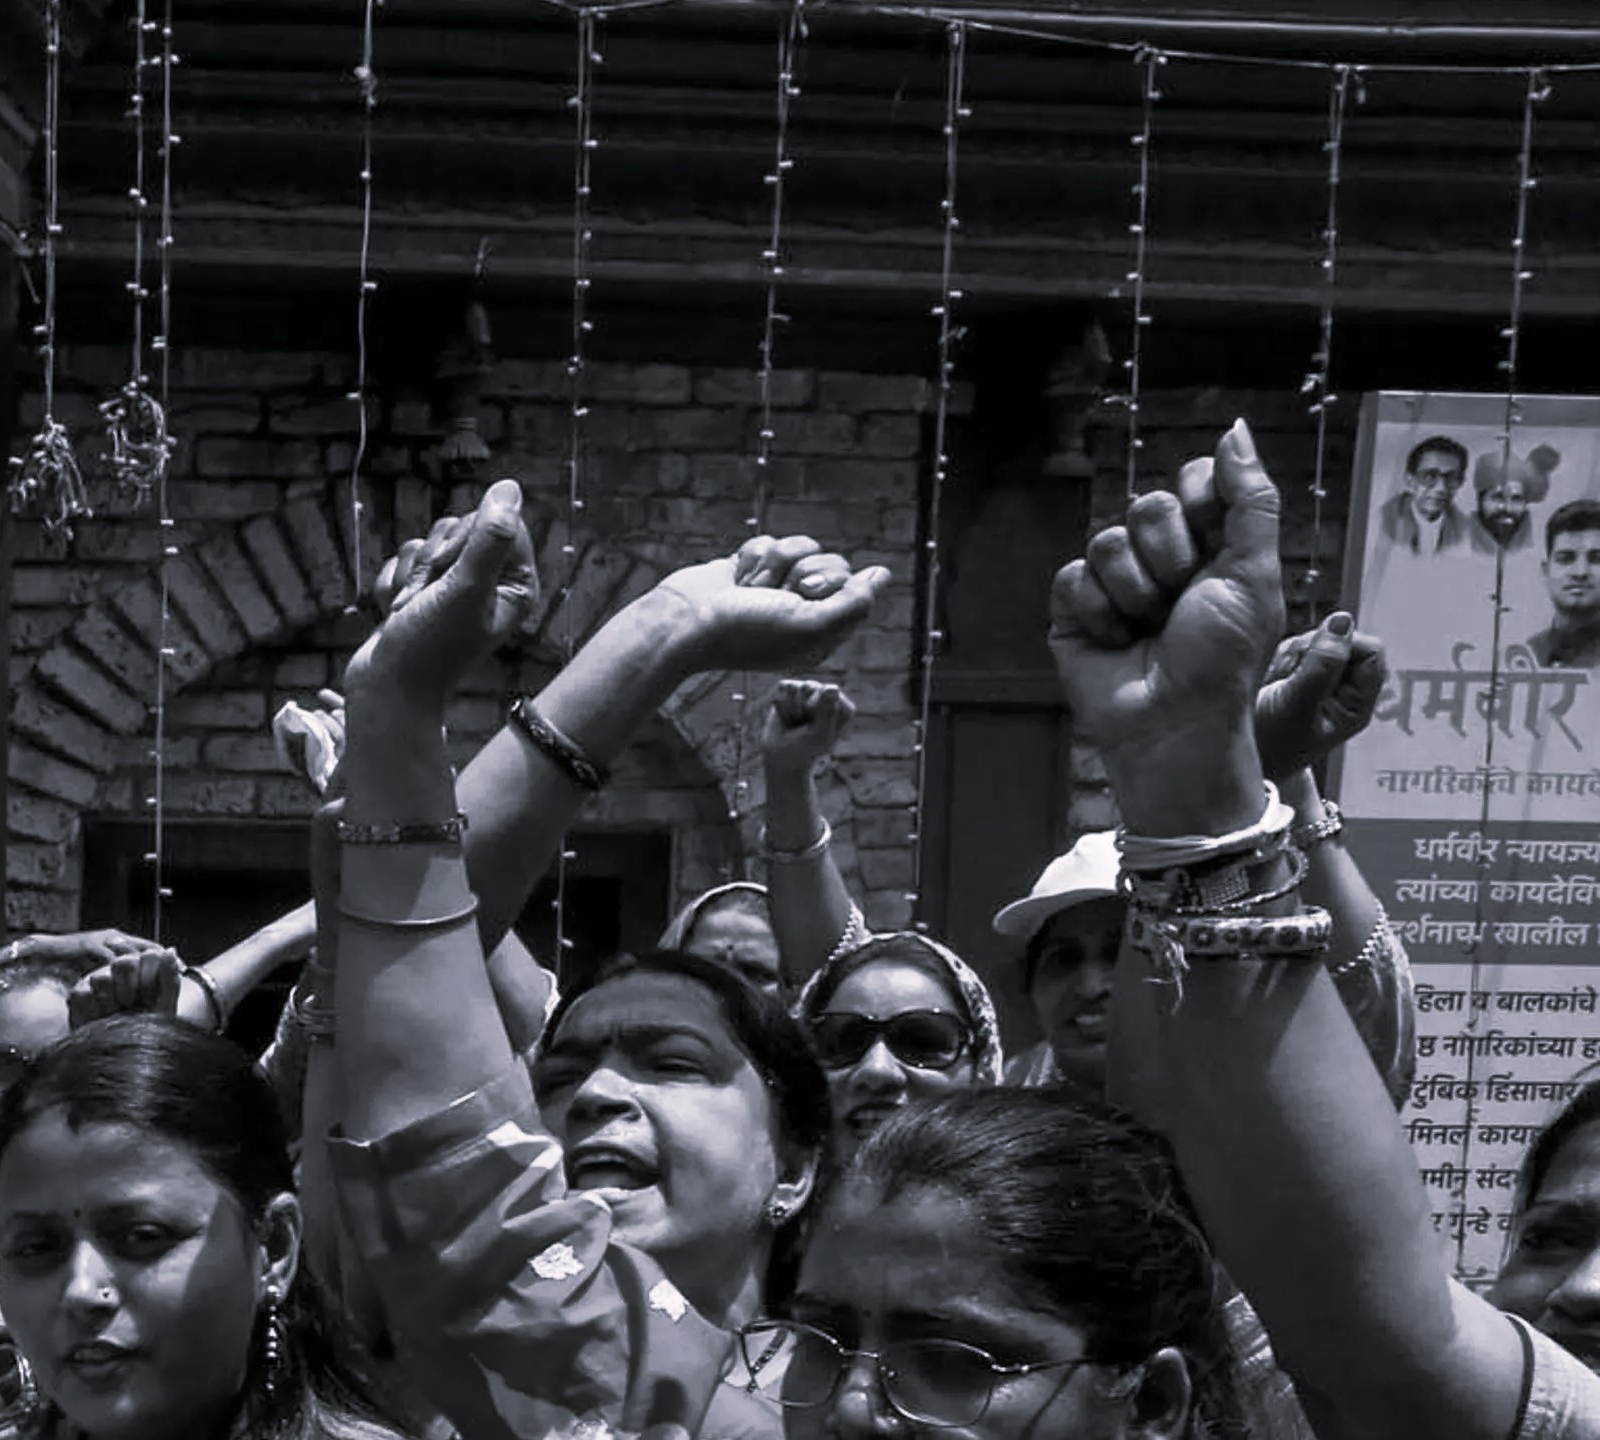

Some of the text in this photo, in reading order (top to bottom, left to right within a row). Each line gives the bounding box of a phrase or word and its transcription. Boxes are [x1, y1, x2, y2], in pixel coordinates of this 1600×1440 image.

[1413, 831, 1500, 863] धर्मवीर
[1394, 873, 1479, 903] त्यांच्या
[1493, 915, 1590, 946] खालील
[1414, 984, 1466, 1013] हिला
[1496, 985, 1598, 1014] बालकांचे
[1442, 1029, 1577, 1058] नागरिकांच्या
[1410, 1073, 1482, 1109] टुंबिक
[1402, 1118, 1472, 1146] मिनल
